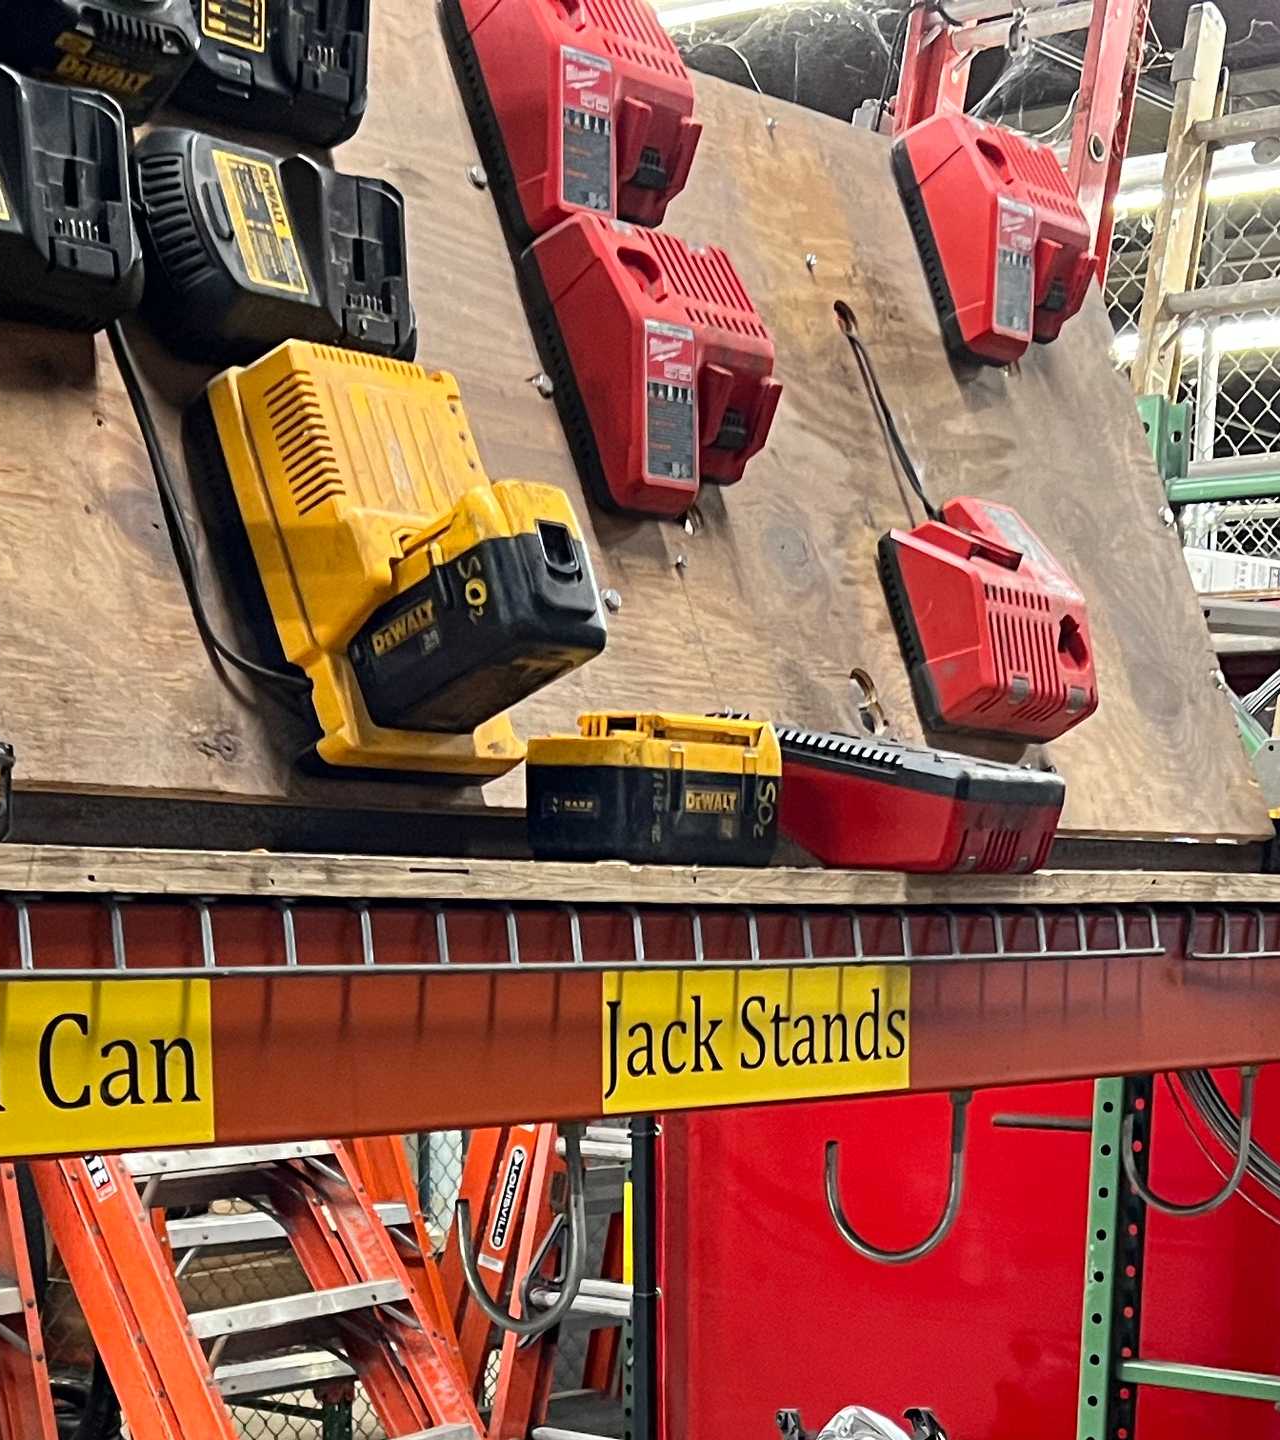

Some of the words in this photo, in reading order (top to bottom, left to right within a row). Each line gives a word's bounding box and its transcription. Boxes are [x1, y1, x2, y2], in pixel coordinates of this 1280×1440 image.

[38, 1012, 201, 1110] Can
[604, 995, 724, 1100] Jack
[740, 987, 907, 1071] Stands
[494, 1164, 520, 1247] LOUISVILLE
